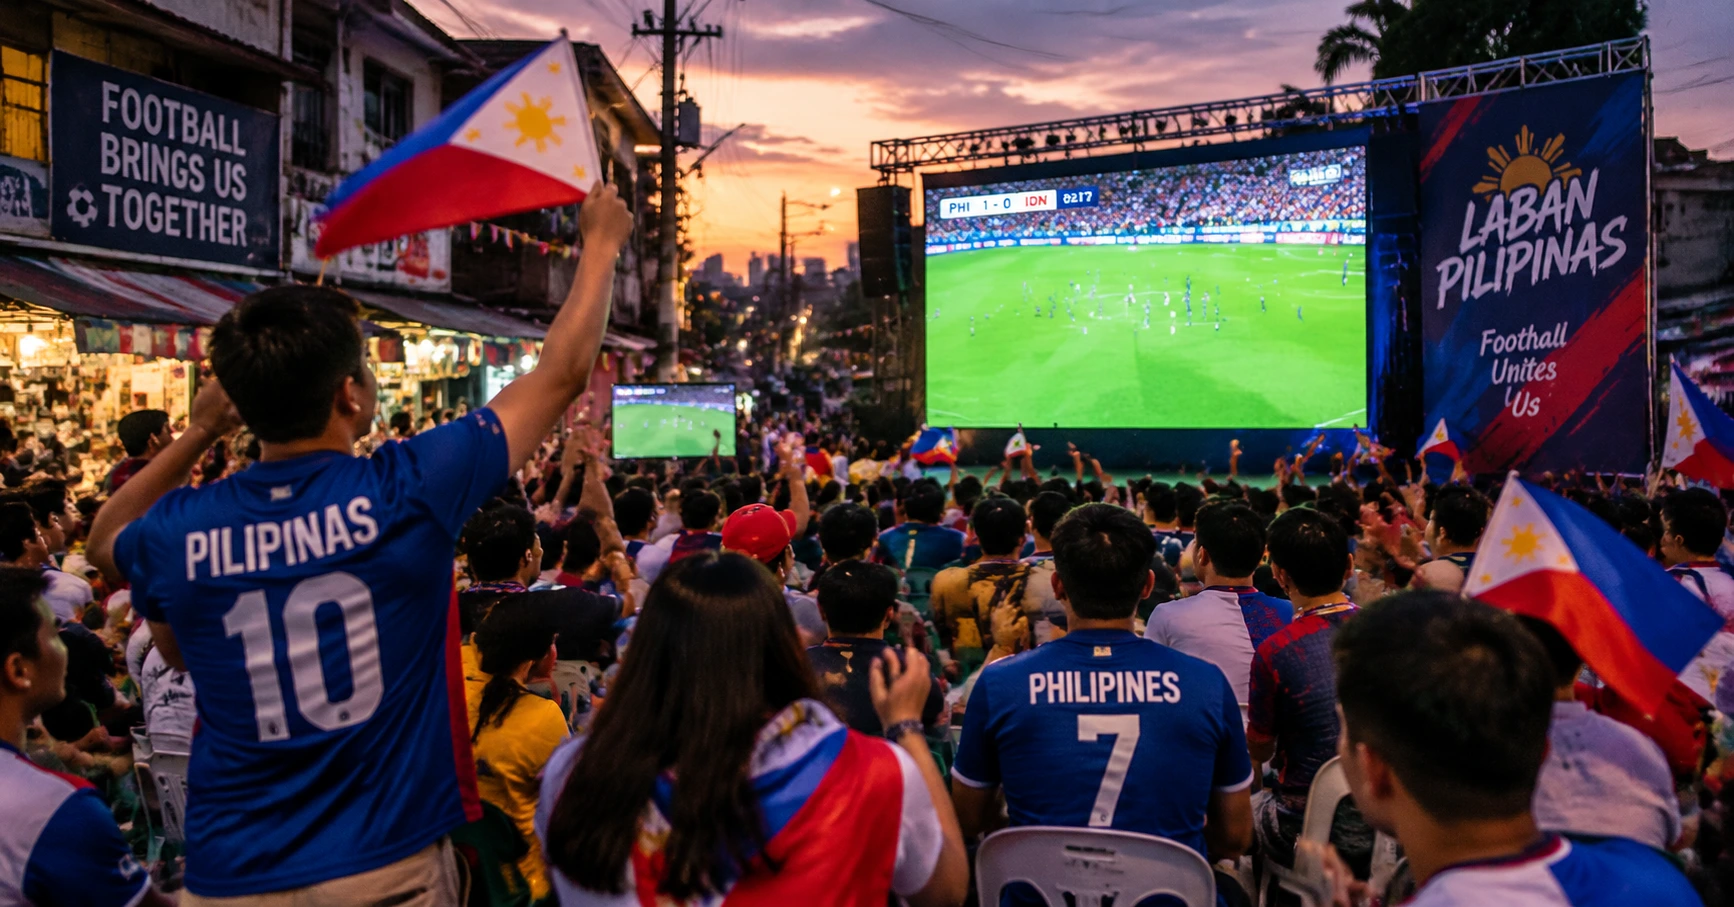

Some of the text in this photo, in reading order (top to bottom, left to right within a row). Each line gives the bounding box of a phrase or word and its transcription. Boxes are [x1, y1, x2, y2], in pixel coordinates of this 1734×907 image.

[102, 80, 246, 156] FOOTBALL
[101, 131, 247, 201] BRINGS US
[101, 183, 248, 247] TOGETHER
[949, 201, 970, 214] PHI
[983, 199, 988, 210] 1
[1003, 197, 1011, 209] 0
[1025, 194, 1047, 207] IDN
[1459, 166, 1599, 255] LABAN
[1436, 214, 1628, 310] PILIPINAS
[1491, 356, 1557, 385] Unites
[1512, 391, 1541, 417] Us
[185, 496, 379, 581] PILIPINAS
[222, 571, 384, 742] 10
[1029, 670, 1181, 705] PHILIPINES
[1077, 714, 1140, 827] 7
